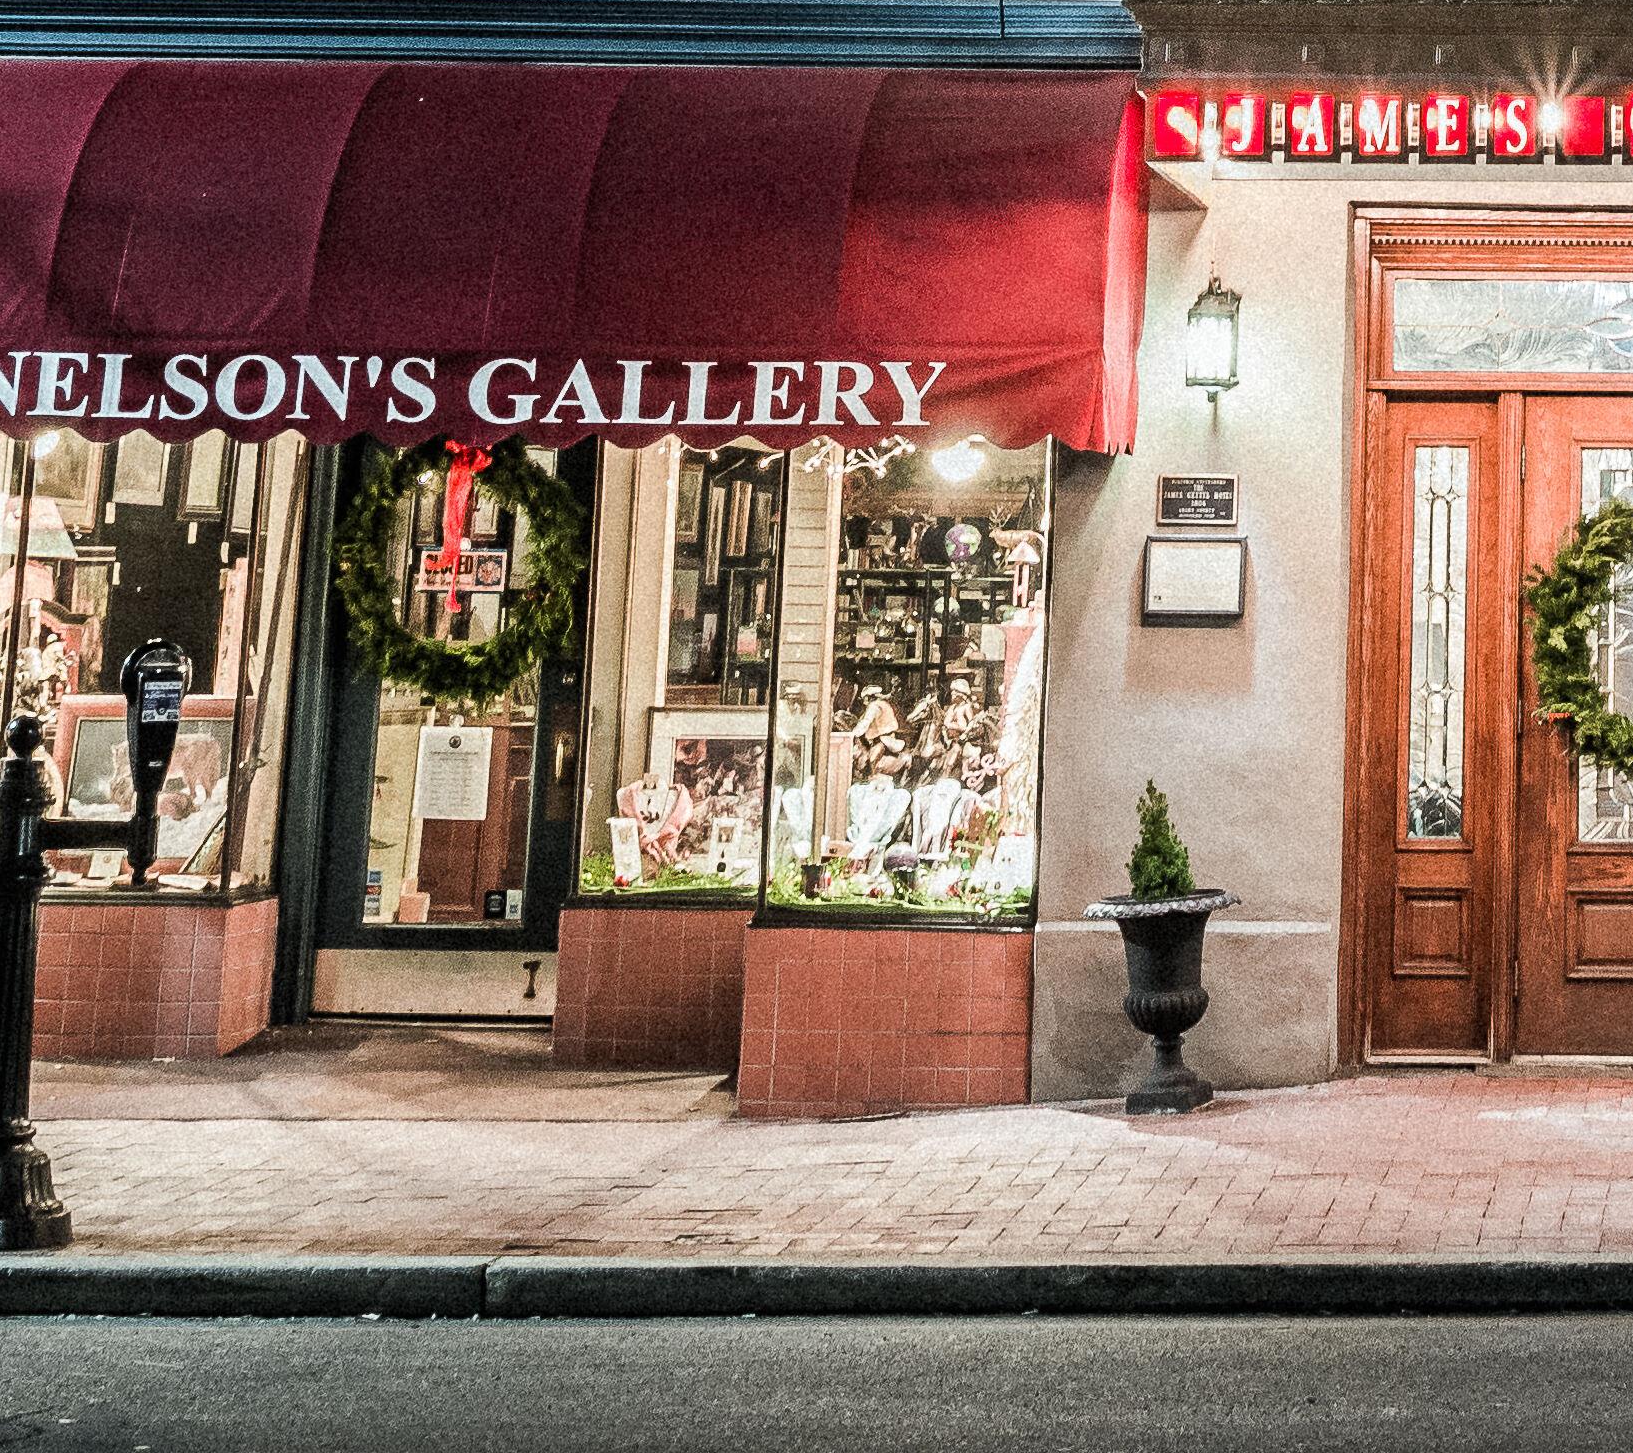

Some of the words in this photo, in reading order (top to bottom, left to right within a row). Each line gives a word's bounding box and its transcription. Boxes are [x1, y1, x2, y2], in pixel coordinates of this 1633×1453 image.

[1231, 99, 1528, 154] JAMES
[469, 356, 948, 426] GALLERY
[424, 553, 474, 575] CED
